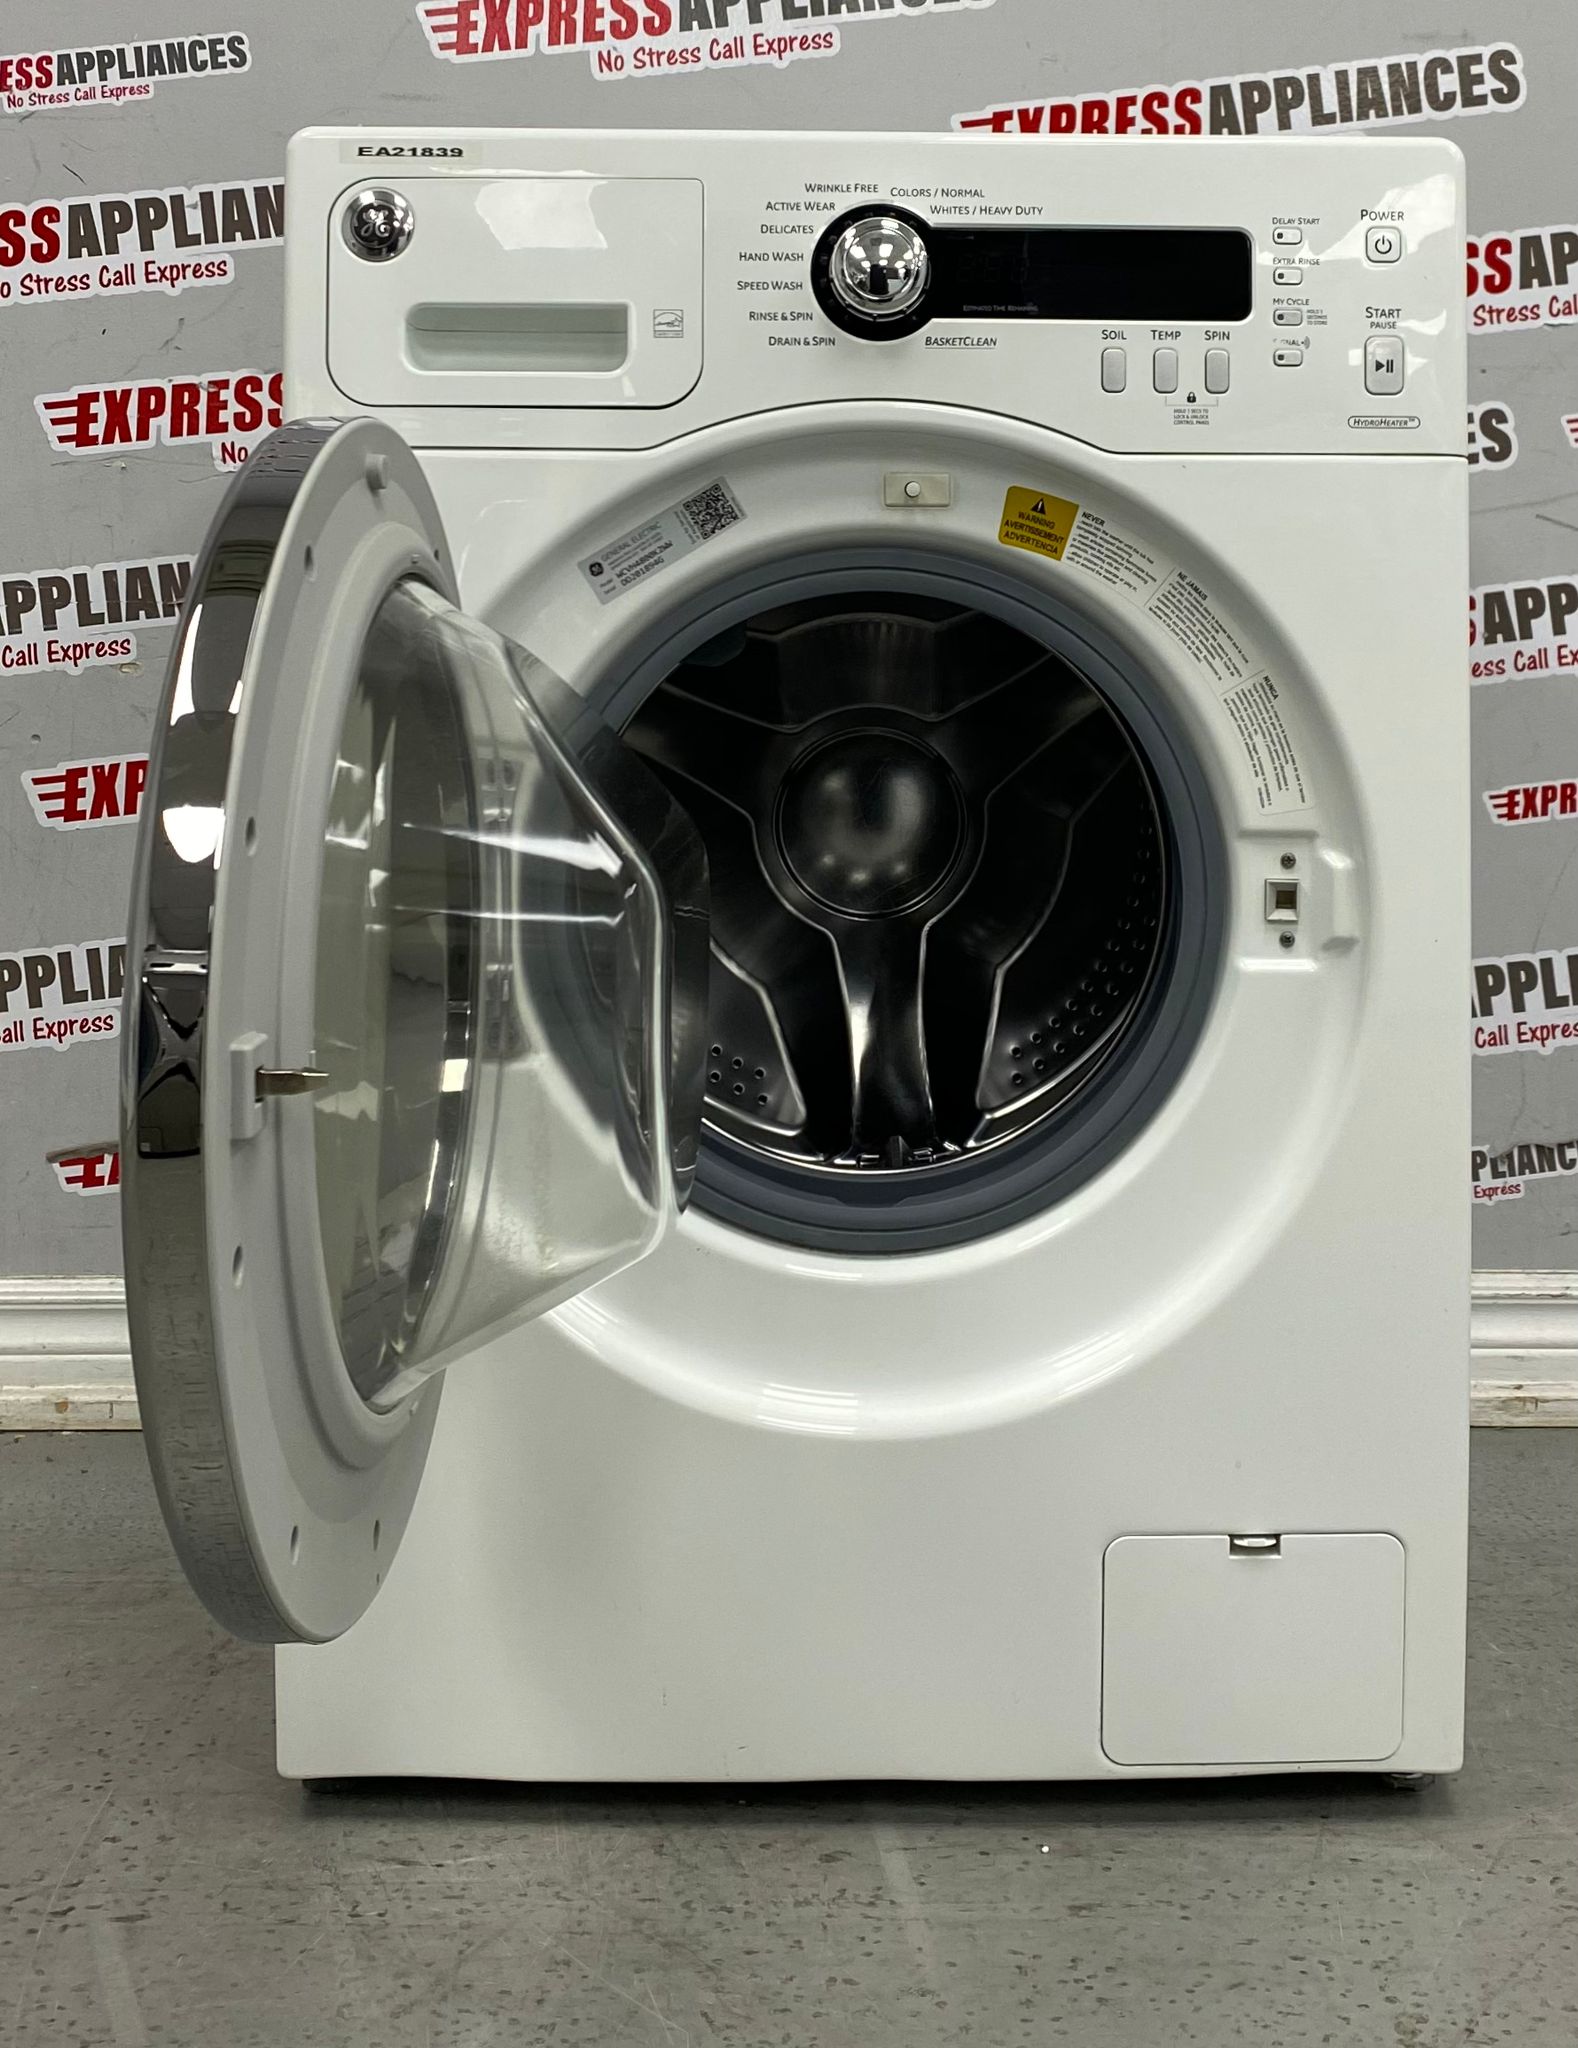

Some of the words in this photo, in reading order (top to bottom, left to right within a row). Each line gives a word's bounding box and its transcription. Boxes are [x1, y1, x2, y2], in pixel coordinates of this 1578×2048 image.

[597, 50, 624, 73] No
[633, 46, 701, 69] Stress
[708, 36, 745, 61] Call
[753, 31, 834, 60] Express
[7, 93, 24, 108] No
[29, 92, 70, 106] Stress
[74, 87, 96, 101] Call
[101, 84, 151, 101] Express
[357, 146, 464, 157] EA21839
[805, 183, 851, 193] WRINKLE
[854, 183, 879, 193] FREE
[890, 187, 931, 197] COLORS
[941, 188, 985, 198] NORMAL
[766, 201, 801, 211] ACTIVE
[804, 201, 836, 211] WEAR
[930, 205, 970, 215] WHITES
[979, 205, 1013, 216] HEAVY
[1015, 206, 1043, 216] DUTY
[1272, 217, 1296, 225] DELAY
[1297, 217, 1320, 225] START
[1360, 209, 1404, 221] POWER
[760, 224, 814, 234] DELICATES
[739, 252, 769, 262] HAND
[772, 252, 804, 262] WASH
[1298, 258, 1321, 266] RINSE
[20, 273, 90, 296] Stress
[99, 263, 136, 288] Call
[144, 260, 228, 287] Express
[737, 280, 769, 290] SPEED
[771, 281, 803, 290] WASH
[1273, 298, 1285, 306] MY
[1286, 298, 1310, 306] CYCLE
[749, 311, 778, 321] RINSE
[781, 312, 788, 321] &
[790, 311, 814, 321] SPIN
[1365, 306, 1402, 319] START
[1473, 304, 1541, 326] Stress
[1370, 321, 1397, 329] PAUSE
[768, 336, 801, 346] DRAIN
[803, 337, 810, 346] &
[812, 336, 836, 346] SPIN
[1101, 329, 1127, 340] SOIL
[1151, 330, 1182, 340] TEMP
[1204, 330, 1230, 341] SPIN
[925, 336, 997, 347] BASKETCLEAN
[220, 441, 248, 464] No
[1018, 511, 1056, 530] WARNING
[1082, 511, 1106, 527] NEVER
[1004, 519, 1064, 544] AVERTISSEMENT
[1003, 530, 1058, 555] ADVERTENCIA
[1177, 571, 1189, 582] NE
[1185, 580, 1208, 601] JAMAIS
[1, 645, 39, 668] Call
[48, 638, 131, 666] Express
[1514, 647, 1549, 672] Call
[1263, 675, 1279, 700] NUNCA
[33, 1015, 114, 1044] Express
[1475, 1024, 1509, 1048] Call
[1474, 1184, 1521, 1200] Express
